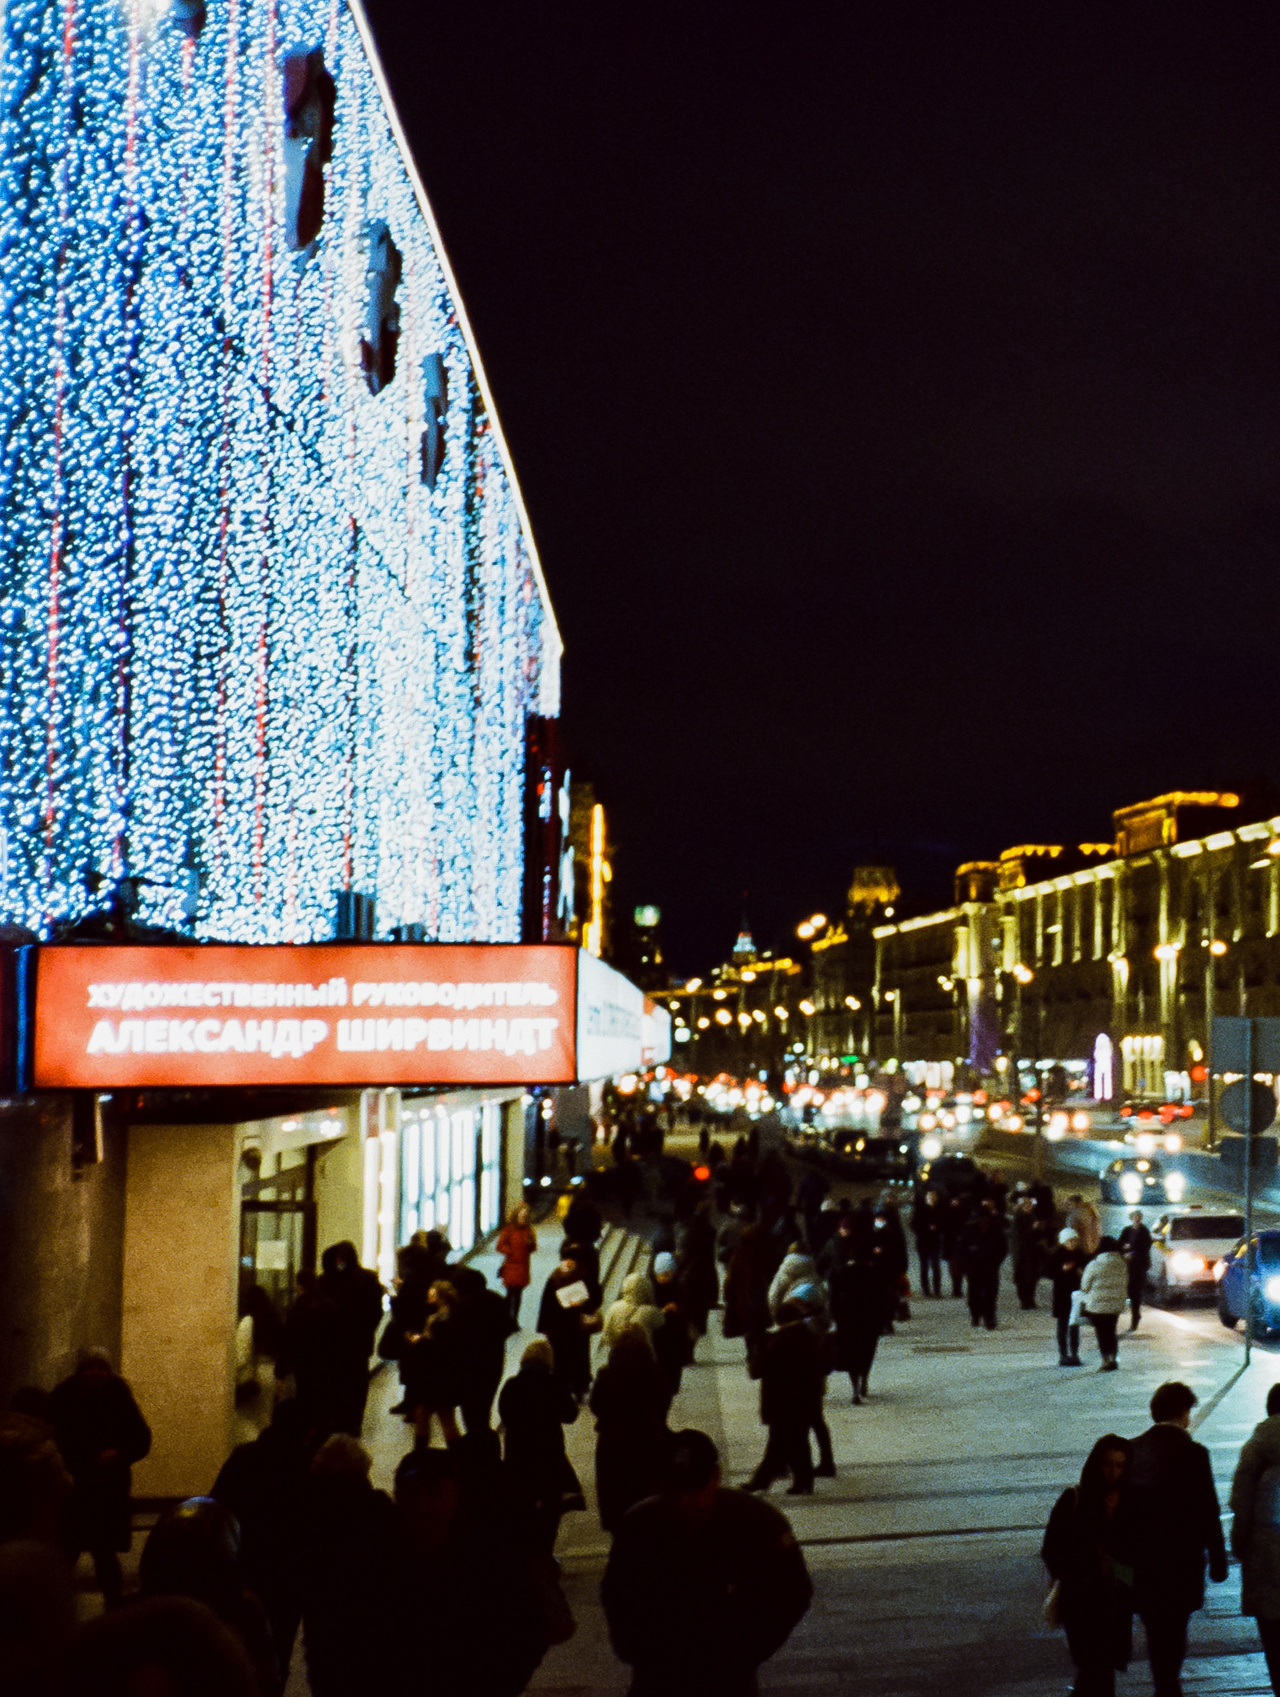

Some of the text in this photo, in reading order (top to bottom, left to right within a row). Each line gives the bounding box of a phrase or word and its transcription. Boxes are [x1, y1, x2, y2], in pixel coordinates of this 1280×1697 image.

[87, 977, 559, 1010] ХУДОЖЕСТВЕННЫЙ РУКОВОДИТЕЛЬ
[86, 1018, 328, 1058] АЛЕКСАНДР
[337, 1018, 559, 1056] ШИРВИНДТ
